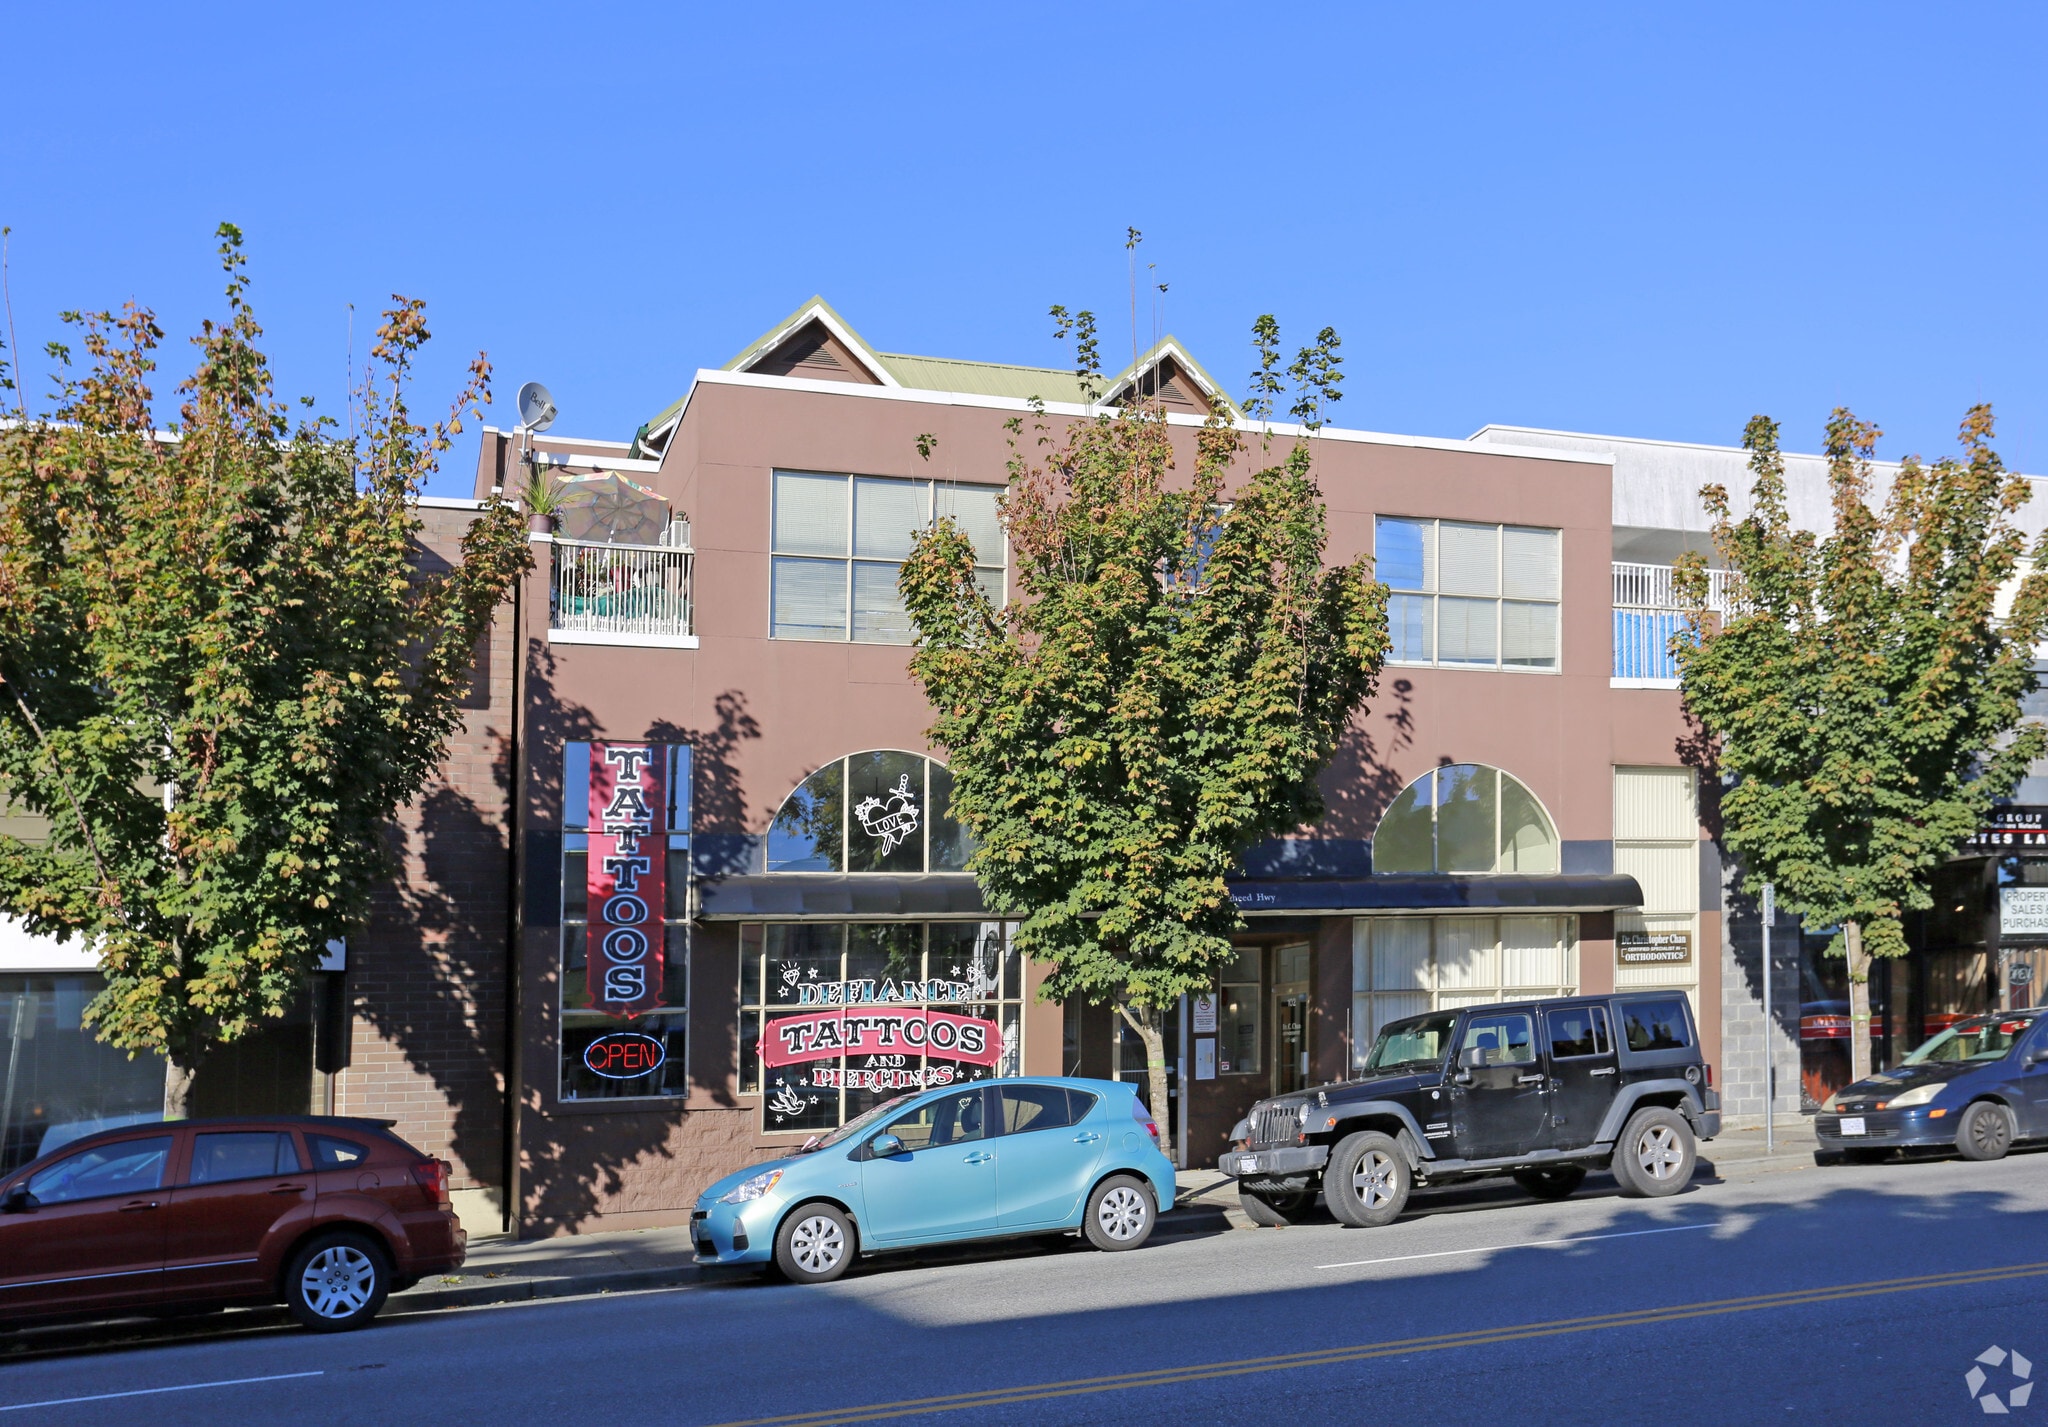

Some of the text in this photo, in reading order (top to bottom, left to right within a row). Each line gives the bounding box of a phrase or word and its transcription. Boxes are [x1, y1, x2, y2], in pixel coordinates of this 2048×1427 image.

[875, 815, 905, 833] LOVE
[1996, 813, 2042, 823] GROUP
[2024, 833, 2048, 844] LA
[603, 747, 653, 1001] TATTOOS
[1256, 893, 1276, 904] Hwy
[2006, 891, 2048, 902] PROPER
[2011, 904, 2043, 915] SALES
[1621, 933, 1687, 946] Dr. Christopher Chan
[1625, 952, 1684, 961] ORTHODONTICS
[797, 978, 970, 1005] DEFIANCE
[780, 1016, 987, 1055] TATTOOS
[589, 1043, 656, 1069] OPEN
[864, 1054, 906, 1068] AND
[812, 1066, 955, 1093] PIERCINGS
